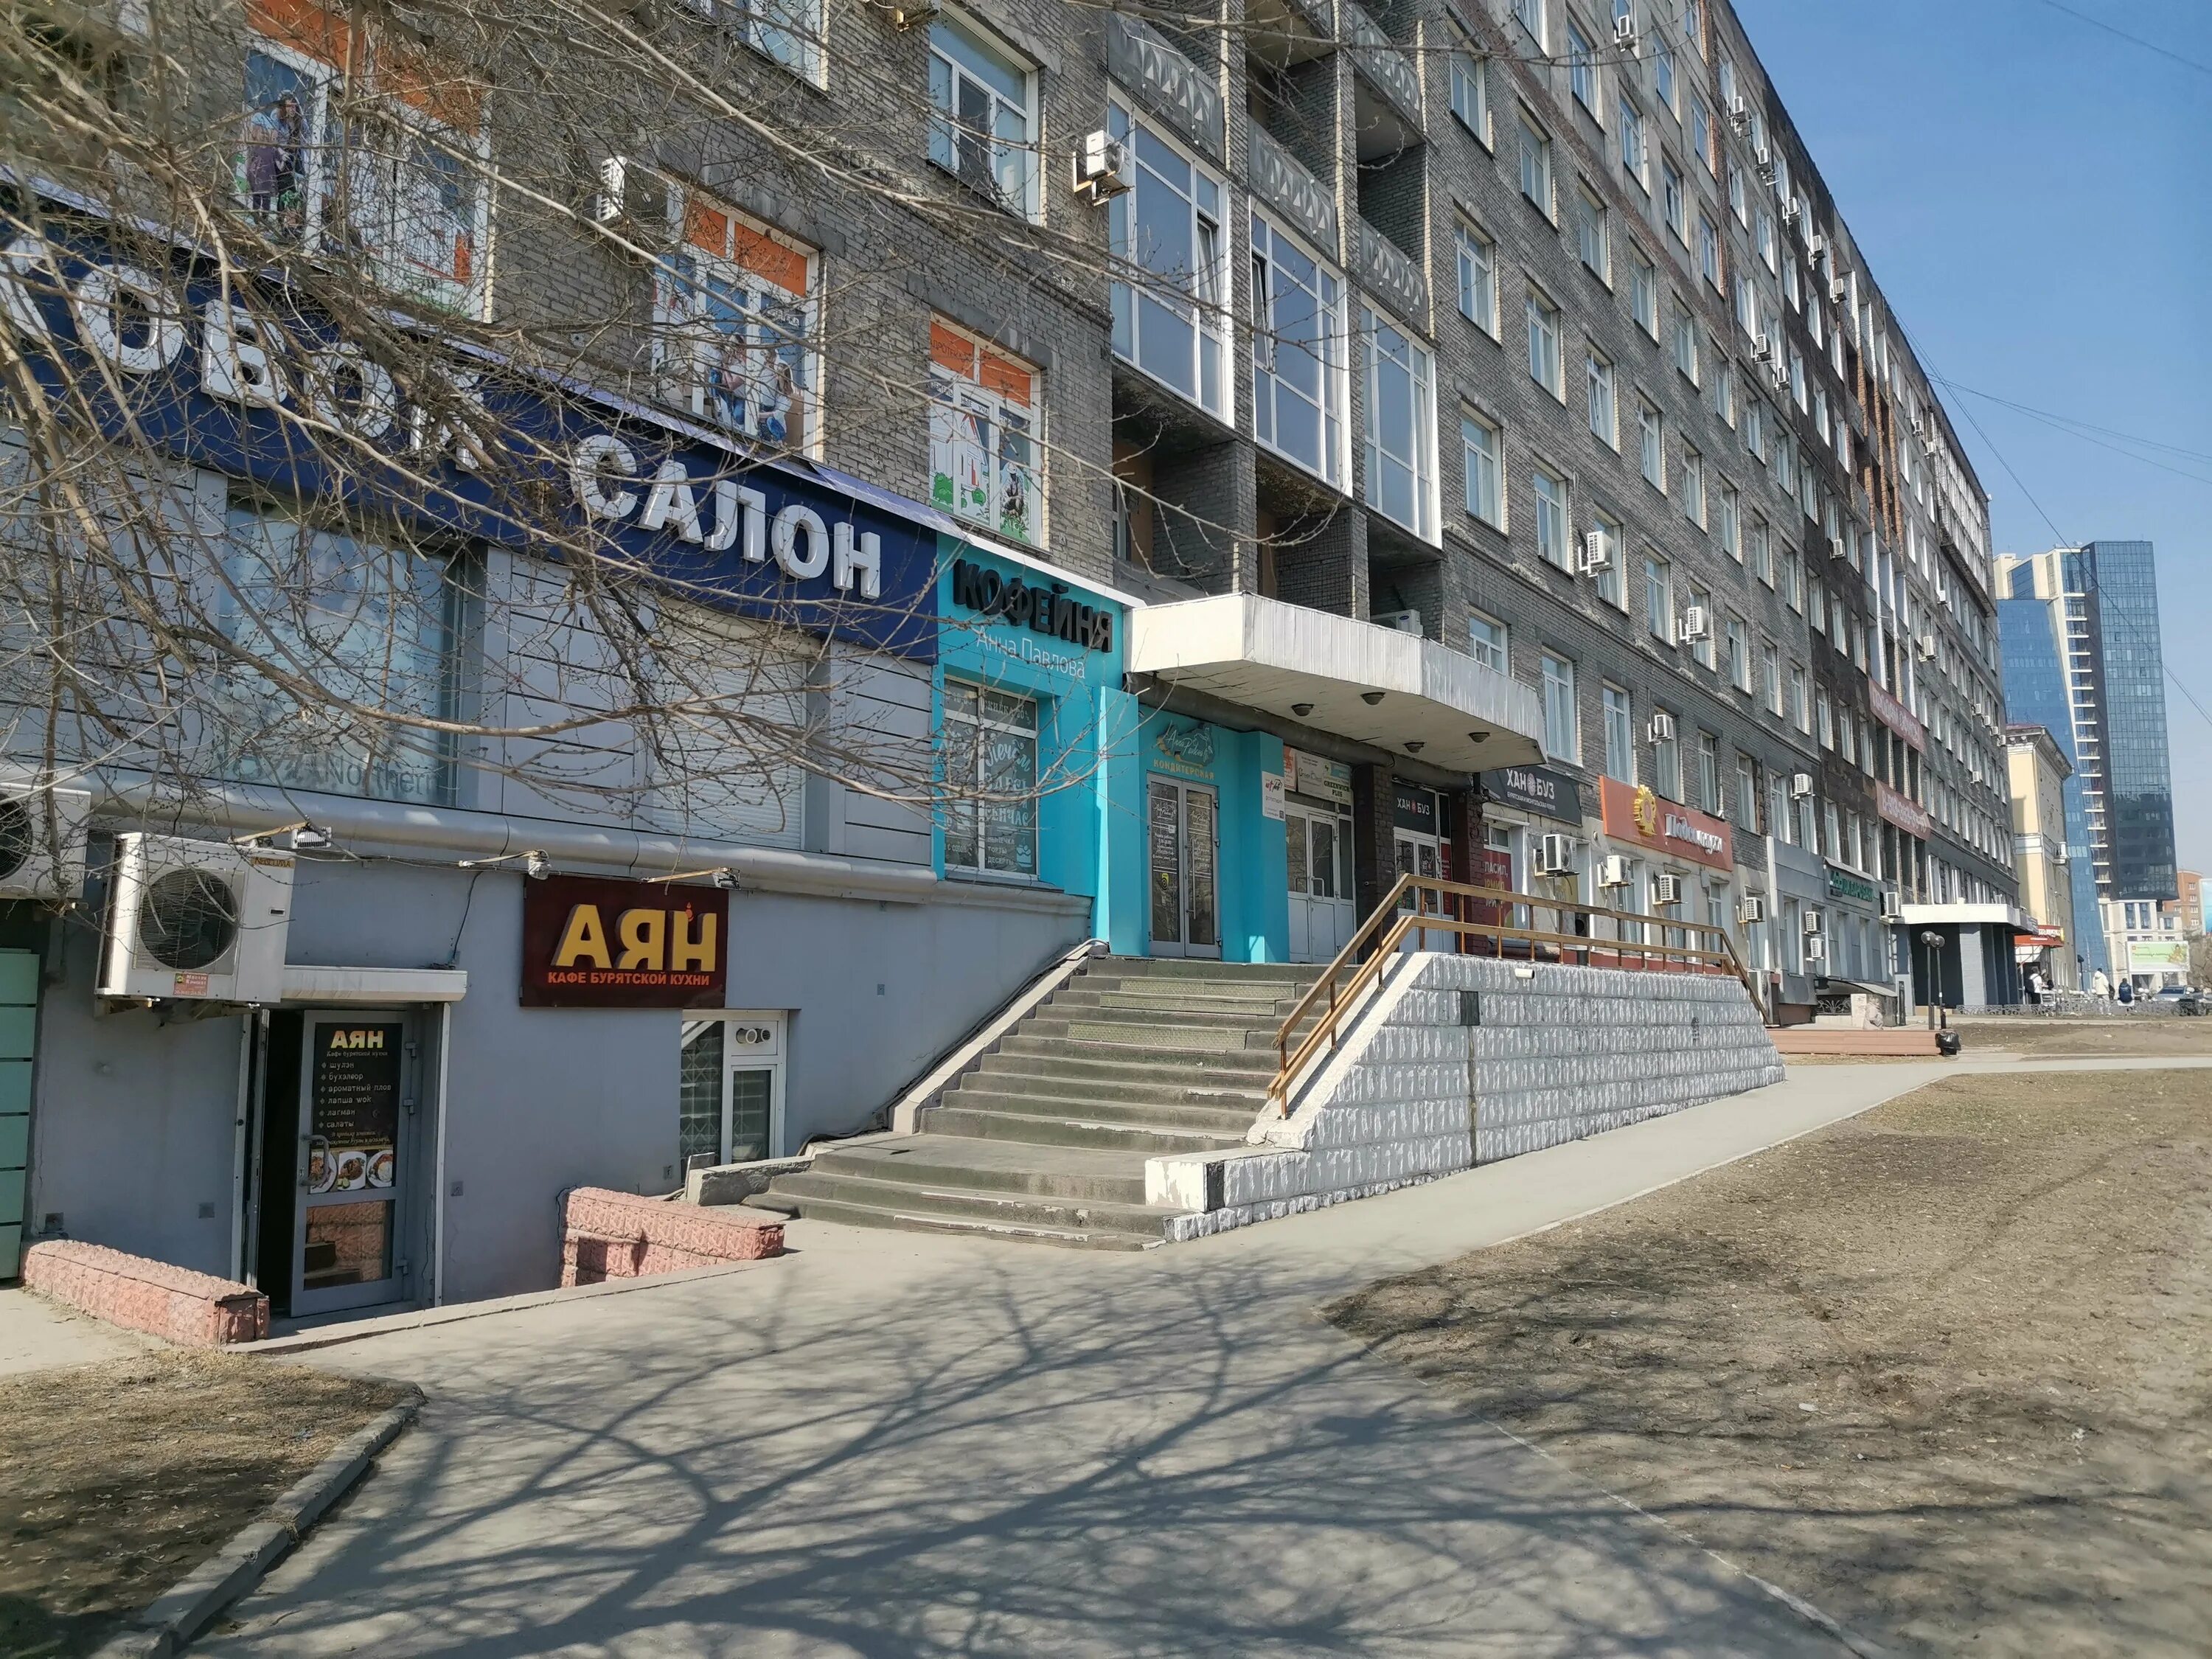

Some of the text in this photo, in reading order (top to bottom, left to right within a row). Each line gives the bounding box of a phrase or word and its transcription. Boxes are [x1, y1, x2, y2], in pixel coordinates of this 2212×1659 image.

[570, 434, 882, 599] САЛОН
[953, 558, 1113, 653] КОФЕЙНЯ
[976, 626, 1085, 679] Анна Павлова
[1153, 758, 1215, 781] КОНДИТЕРСКАЯ
[1506, 768, 1555, 800] ХАН БУЗ
[1332, 790, 1343, 798] PLUS
[1397, 796, 1430, 815] ХАН БУЗ
[551, 902, 717, 973] АЯН
[548, 970, 710, 986] КАФЕ БУРЯТСКОЙ КУХНИ
[330, 1030, 384, 1048] АЯН
[330, 1062, 355, 1071] шулэн
[328, 1084, 372, 1093] ароматный
[356, 1095, 372, 1104] wok
[327, 1108, 356, 1116] лагман
[326, 1120, 355, 1129] салаты
